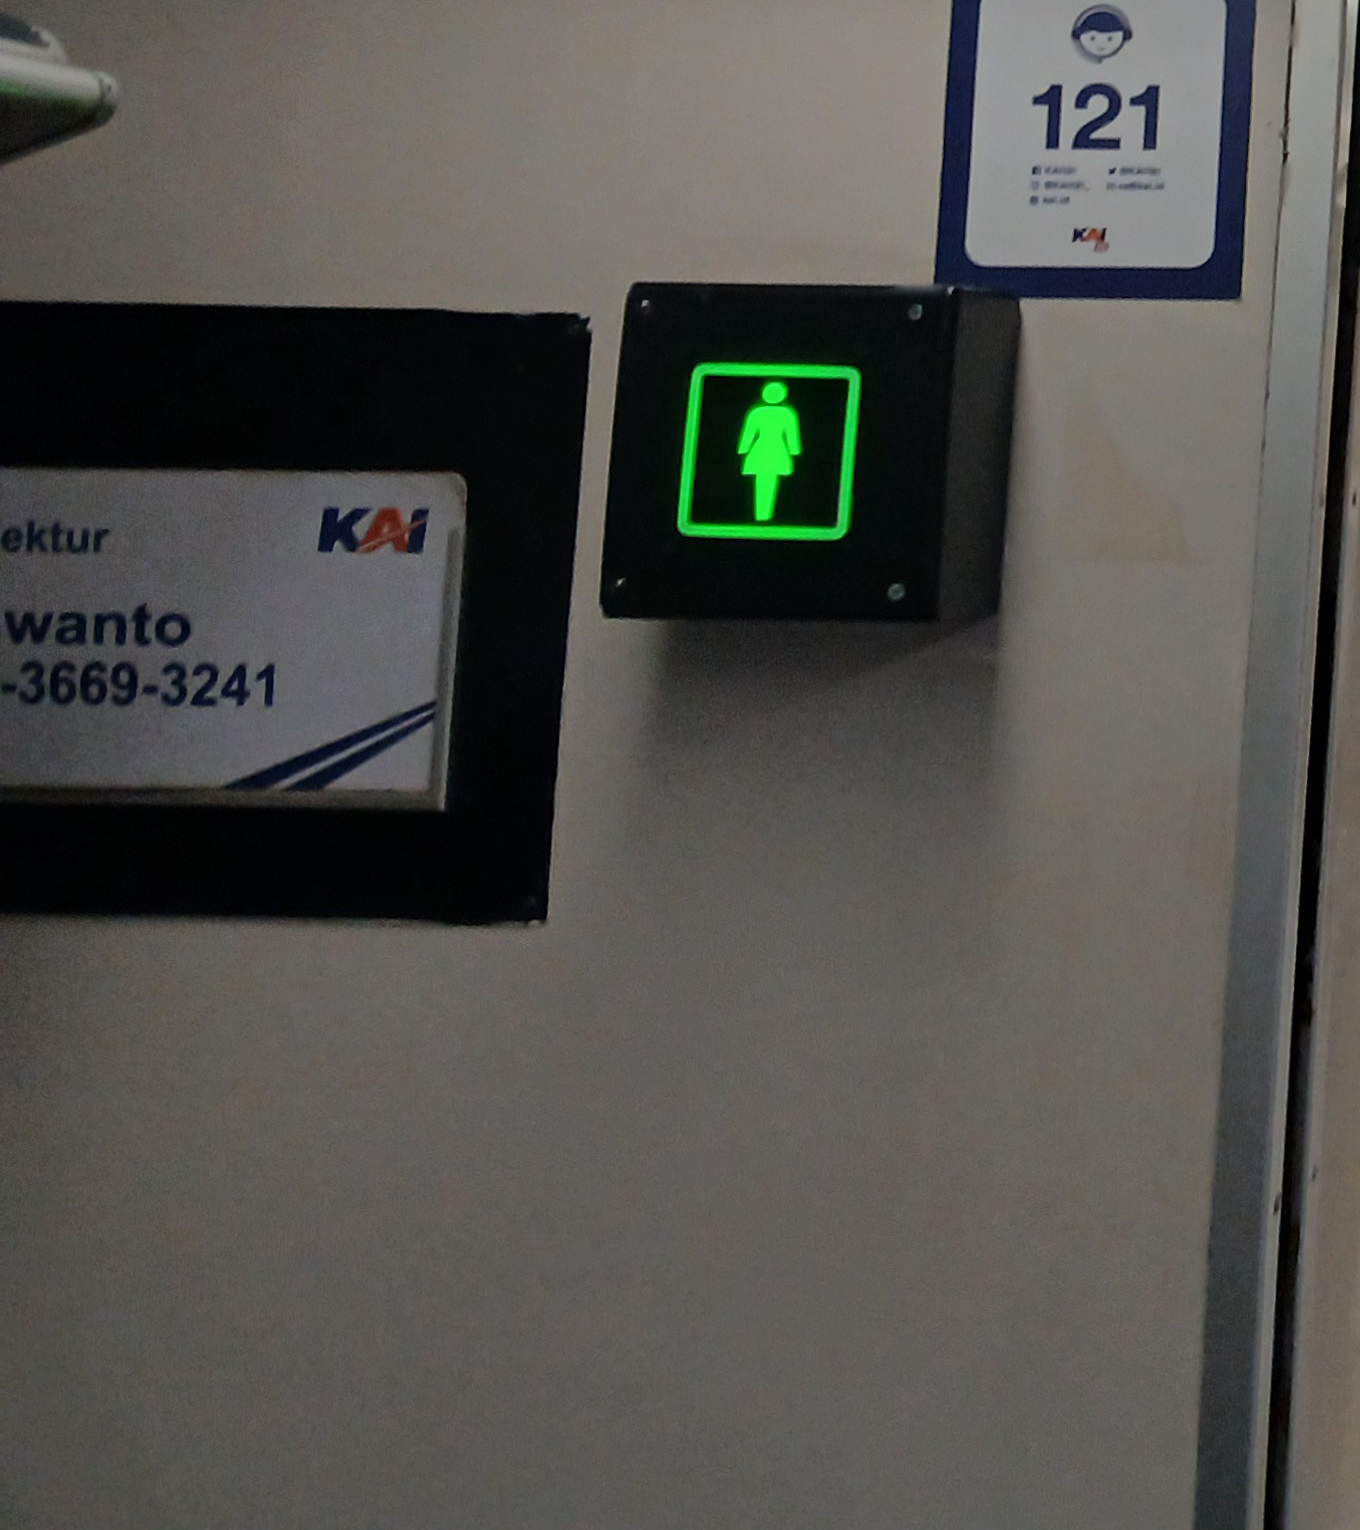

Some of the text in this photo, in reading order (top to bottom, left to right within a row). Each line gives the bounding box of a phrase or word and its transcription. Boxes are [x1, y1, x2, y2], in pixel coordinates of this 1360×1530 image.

[1031, 83, 1160, 151] 121
[317, 507, 429, 554] KAI
[4, 603, 192, 647] wanto
